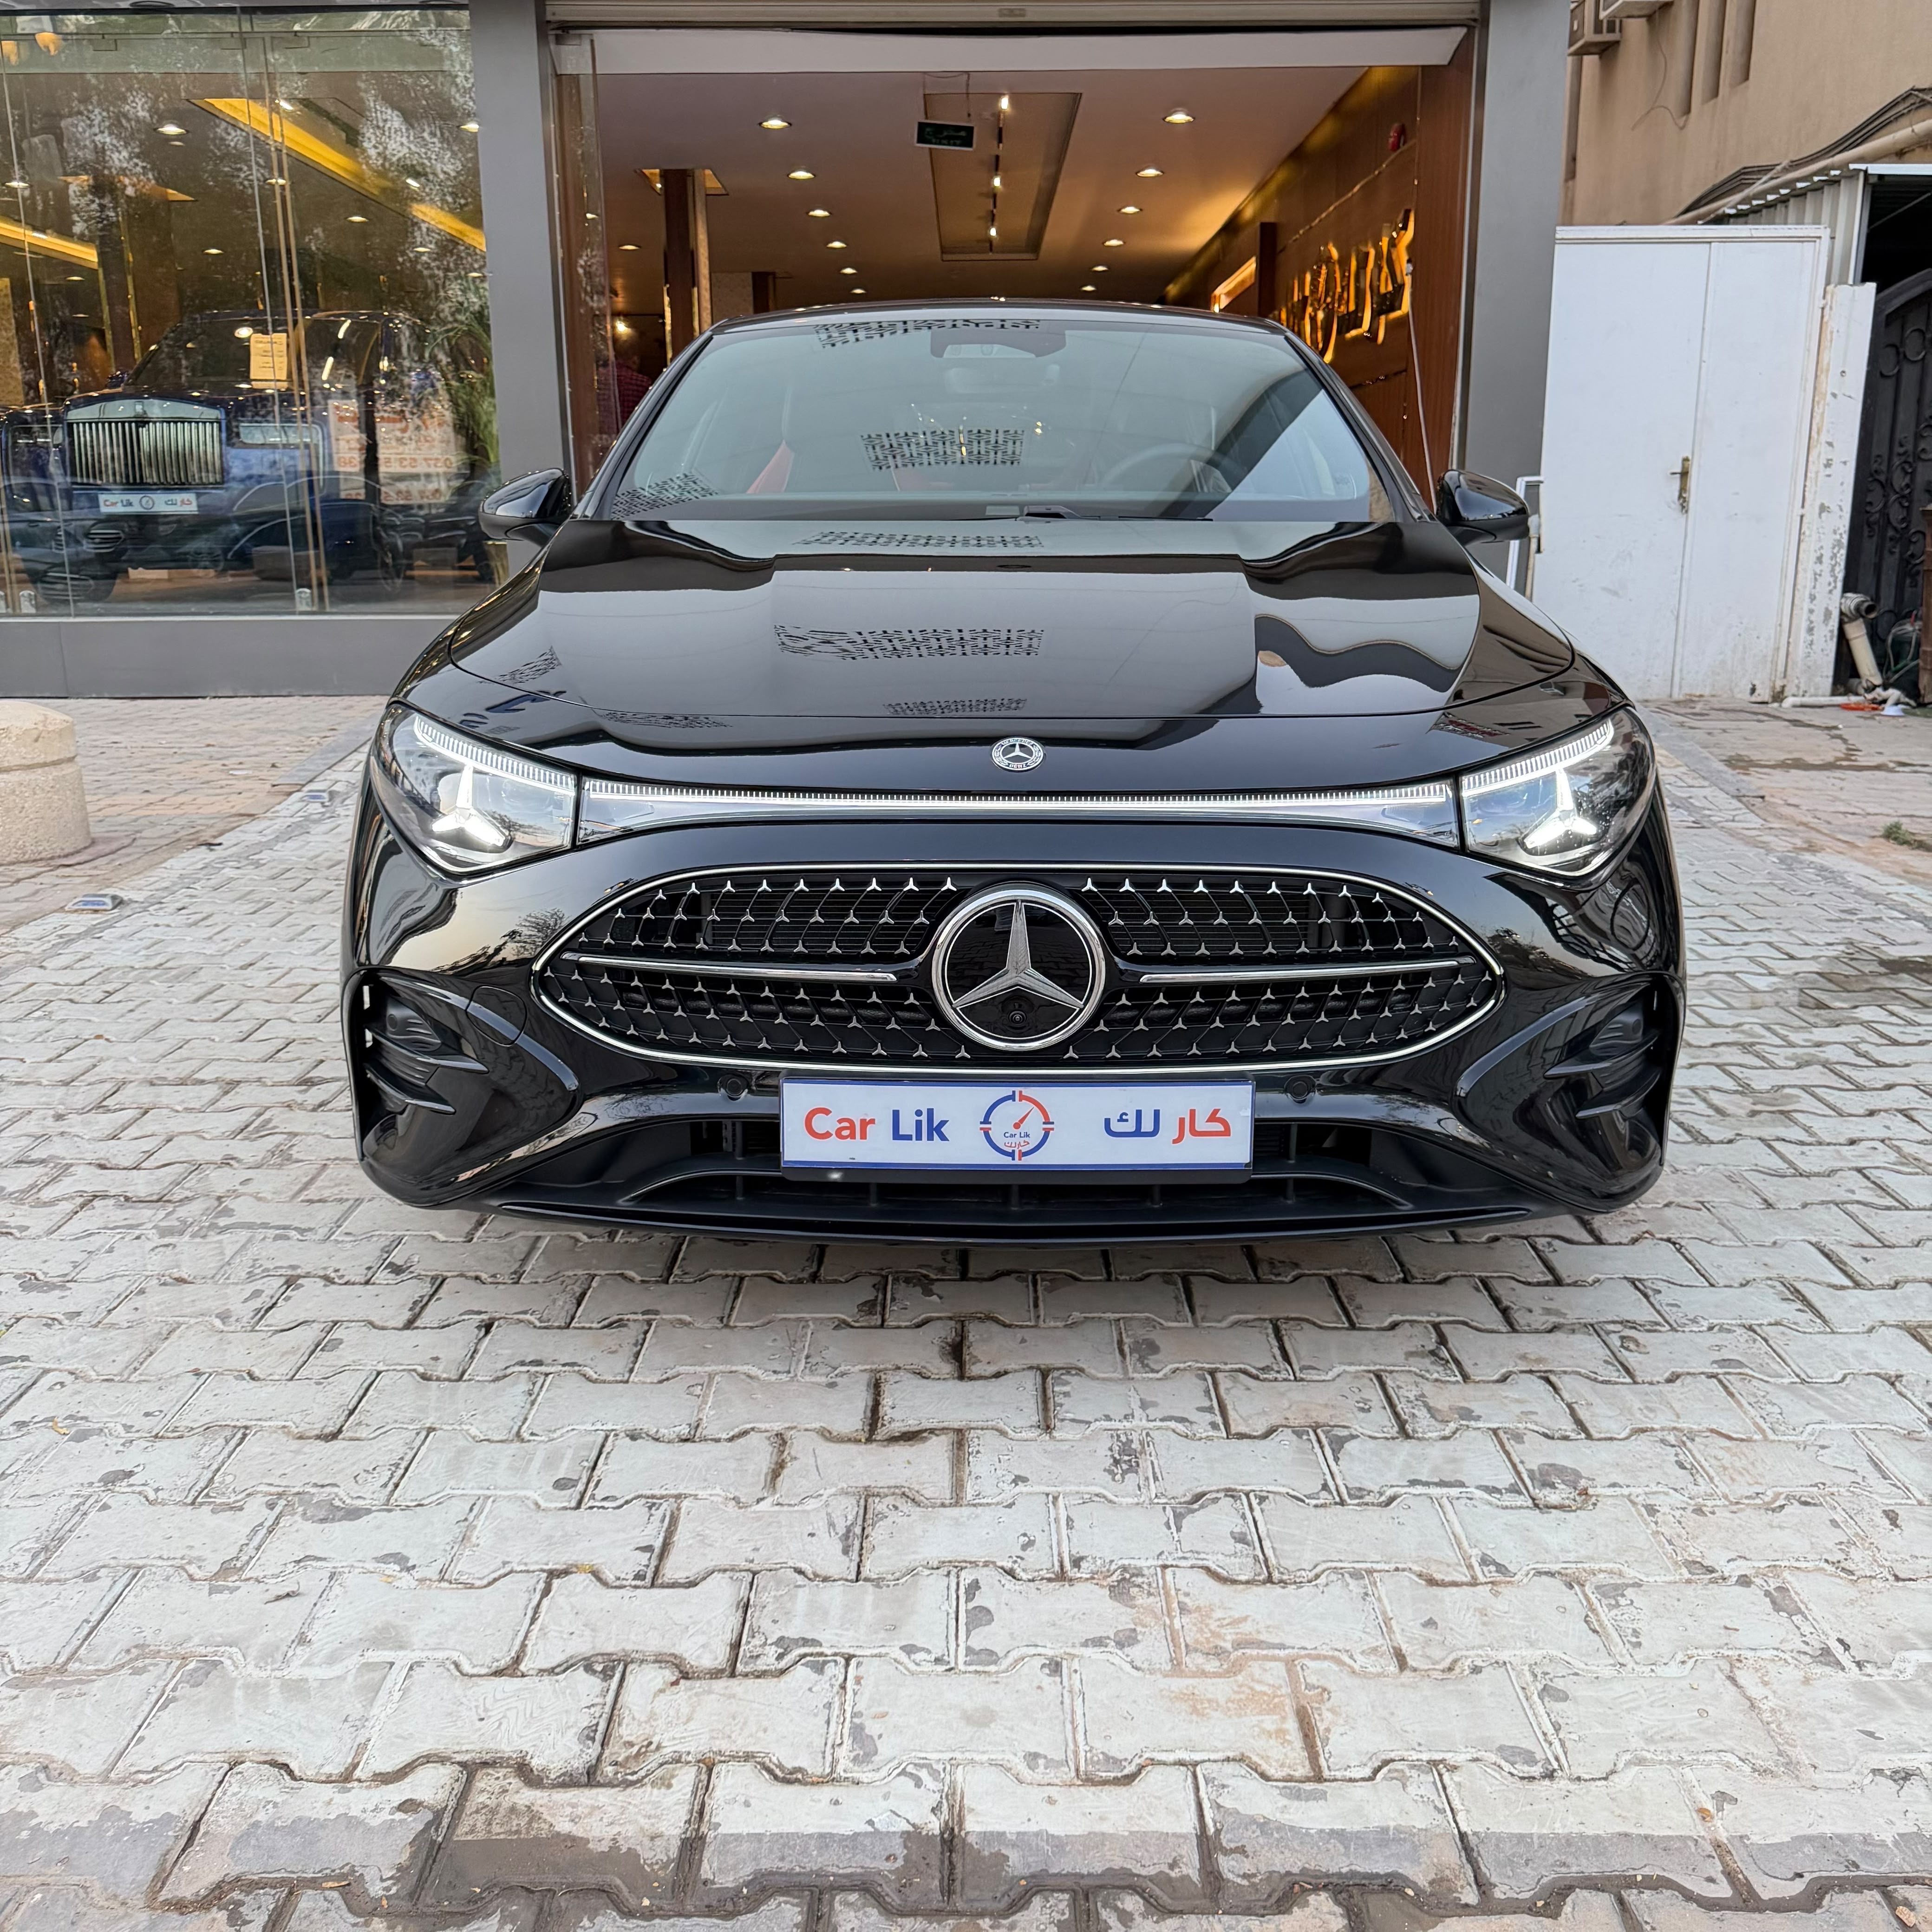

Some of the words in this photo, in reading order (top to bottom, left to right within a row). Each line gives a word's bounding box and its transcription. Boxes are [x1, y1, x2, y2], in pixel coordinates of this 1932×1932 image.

[804, 1107, 875, 1140] Car
[892, 1108, 950, 1142] Lik
[1104, 1109, 1161, 1138] لك
[1172, 1108, 1231, 1144] كار
